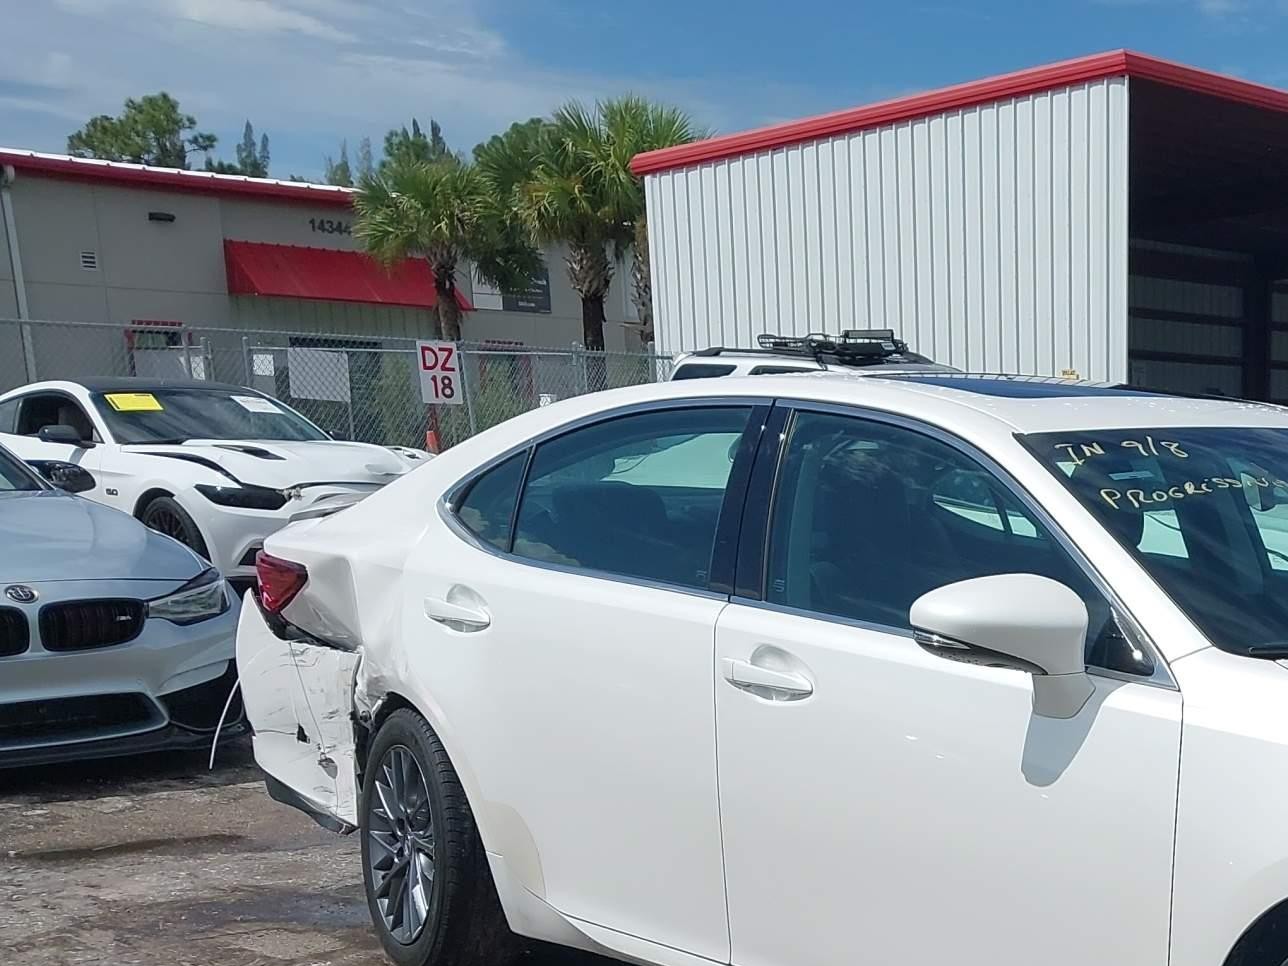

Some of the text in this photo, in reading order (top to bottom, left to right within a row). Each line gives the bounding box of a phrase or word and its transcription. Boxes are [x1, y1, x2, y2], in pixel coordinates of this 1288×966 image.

[420, 345, 456, 373] DZ
[430, 374, 455, 399] 18
[1054, 435, 1189, 466] IN 9/8
